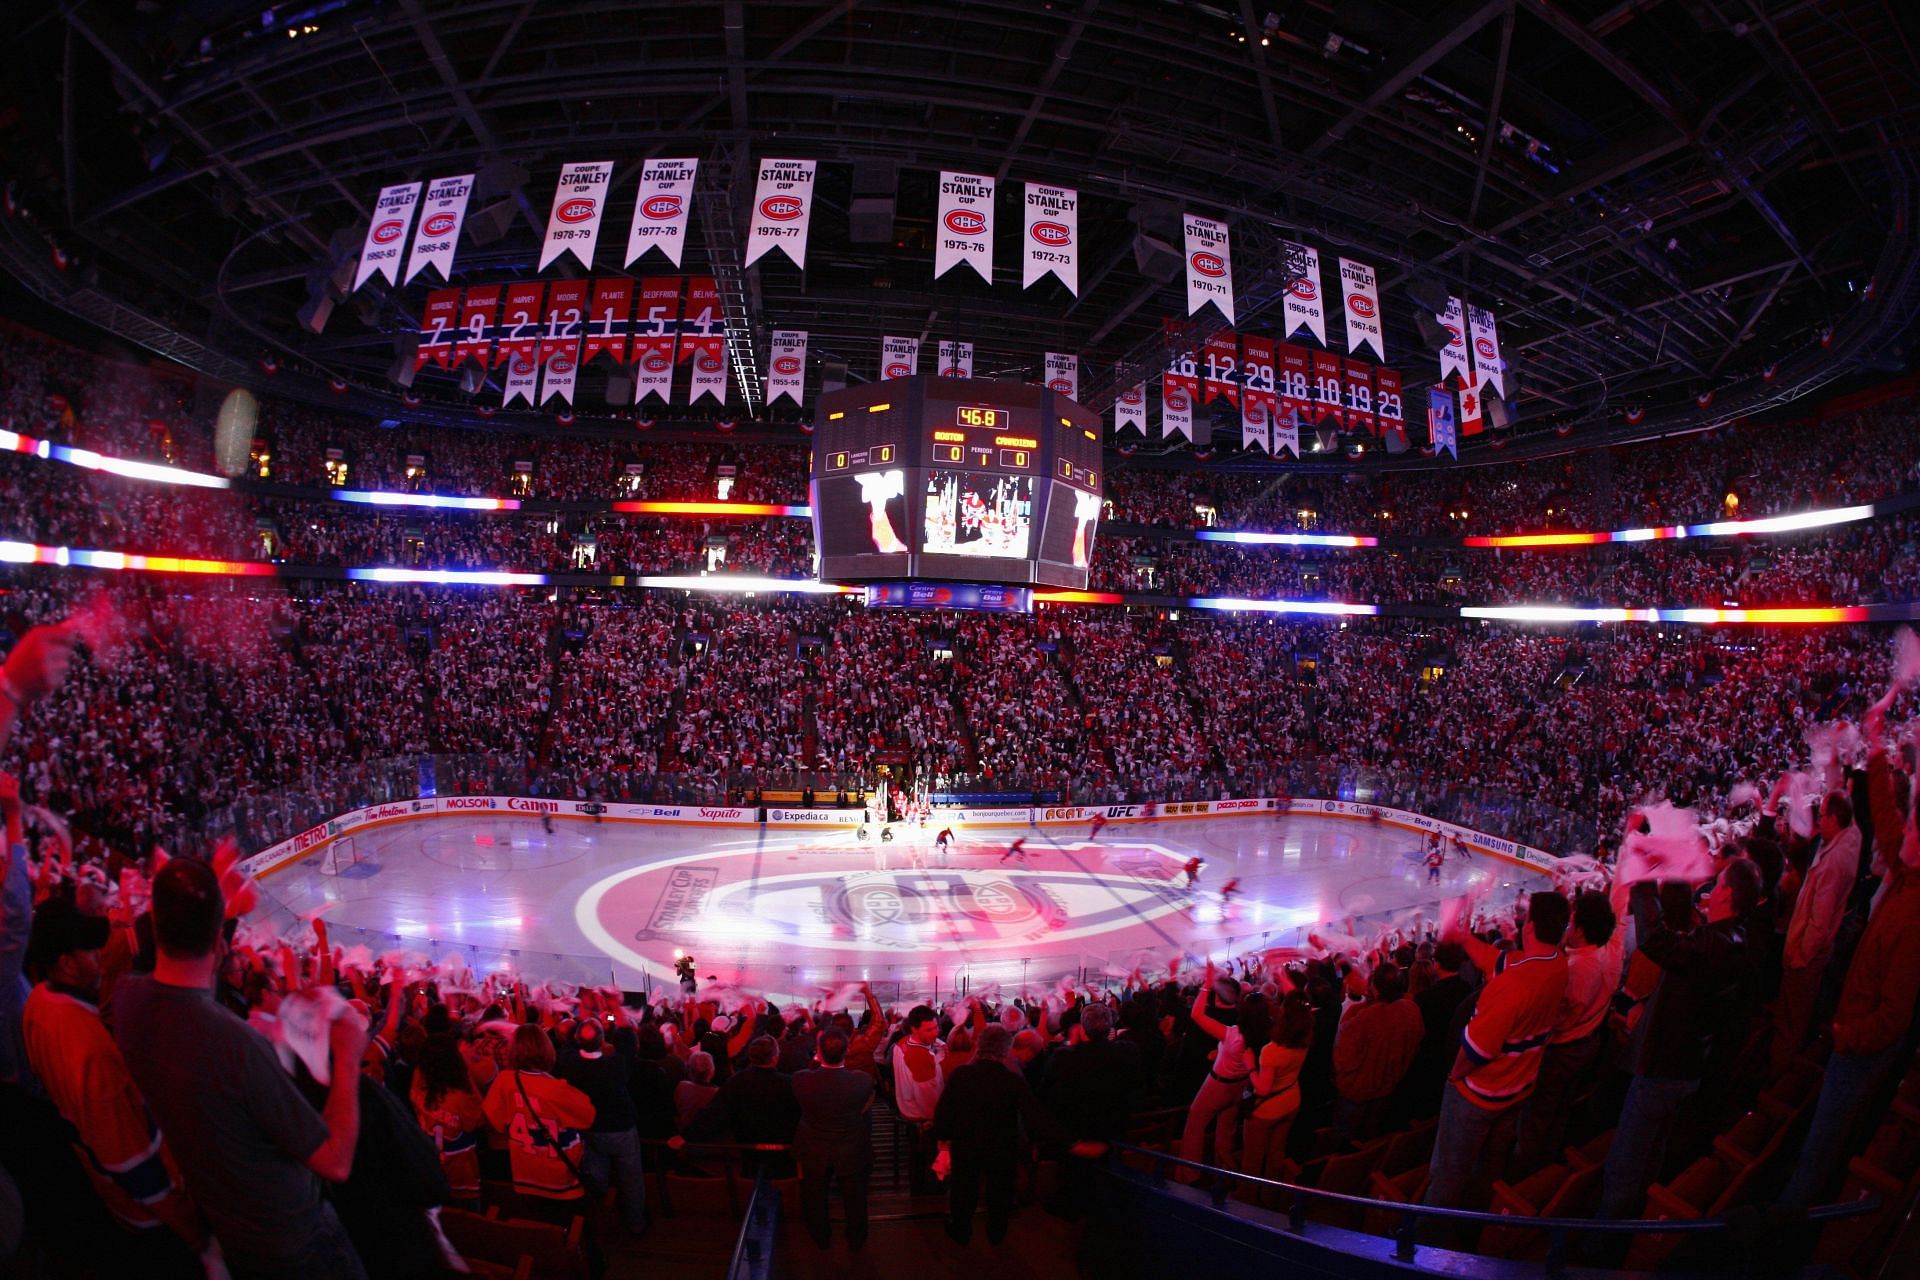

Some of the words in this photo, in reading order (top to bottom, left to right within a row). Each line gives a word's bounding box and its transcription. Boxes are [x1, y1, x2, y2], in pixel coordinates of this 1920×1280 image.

[657, 161, 684, 169] COUPE
[561, 172, 609, 186] STANLEY
[643, 169, 694, 181] STANLEY
[761, 169, 813, 182] STANLEY
[954, 175, 982, 185] COUPE
[427, 185, 470, 201] STANLEY
[776, 182, 794, 190] CUP
[942, 182, 993, 198] STANLEY
[1038, 187, 1065, 198] COUPE
[378, 193, 417, 209] STANLEY
[438, 199, 453, 207] CUP
[958, 196, 975, 205] CUP
[1027, 193, 1076, 211] STANLEY
[387, 207, 401, 215] CUP
[1043, 208, 1060, 217] CUP
[637, 226, 678, 236] 1977-78
[757, 226, 800, 237] 1976-77
[1194, 219, 1217, 231] COUPE
[552, 229, 591, 240] 1978-79
[1185, 225, 1227, 244] STANLEY
[943, 239, 985, 253] 1975-76
[1200, 239, 1215, 248] CUP
[1031, 250, 1071, 265] 1972-73
[1348, 262, 1367, 274] COUPE
[1342, 268, 1374, 287] STANLEY
[1192, 279, 1227, 295] 1970-71
[600, 291, 625, 300] PLANTE
[1288, 302, 1319, 318] 1968-69
[467, 313, 486, 344] 9
[509, 311, 529, 341] 2
[545, 308, 581, 340] 12
[600, 307, 614, 338] 1
[646, 306, 667, 338] 5
[693, 306, 714, 338] 4
[1350, 319, 1378, 335] 1967-68
[1469, 313, 1494, 331] STANLEY
[430, 316, 448, 347] 7
[773, 338, 806, 347] STANLEY
[884, 343, 917, 354] STANLEY
[940, 348, 972, 359] STALEY
[1248, 348, 1269, 359] DRYDEN
[1046, 360, 1076, 372] STANLEY
[1207, 352, 1237, 385] 12
[1316, 361, 1337, 373] LAFLEUR
[1245, 362, 1274, 393] 29
[1283, 369, 1307, 401] 18
[1317, 375, 1340, 406] 10
[1349, 383, 1371, 413] 19
[1378, 391, 1402, 421] 23
[961, 409, 995, 427] 46.8
[934, 431, 965, 442] BOSTON
[837, 453, 845, 467] 0
[882, 447, 890, 461] 0
[950, 446, 961, 461] 0
[1016, 452, 1025, 466] 0
[1065, 463, 1071, 476] 0
[909, 584, 936, 592] Centre
[979, 587, 1004, 595] Centre
[446, 798, 489, 809] MOLSON
[507, 797, 559, 812] Canon
[1216, 800, 1238, 811] pizza
[1237, 800, 1259, 810] pizza
[363, 808, 378, 822] Tim
[378, 806, 408, 818] Hortons
[652, 808, 680, 817] Bell
[697, 807, 742, 821] Saputo
[784, 811, 829, 822] Expedia.ca
[1045, 807, 1085, 820] AGAT
[1107, 806, 1136, 818] UFC
[1414, 817, 1433, 828] Bell
[293, 825, 328, 852] METRO
[1472, 833, 1514, 854] SAMSUNG
[653, 887, 686, 929] STANLEY
[509, 1112, 559, 1158] 47
